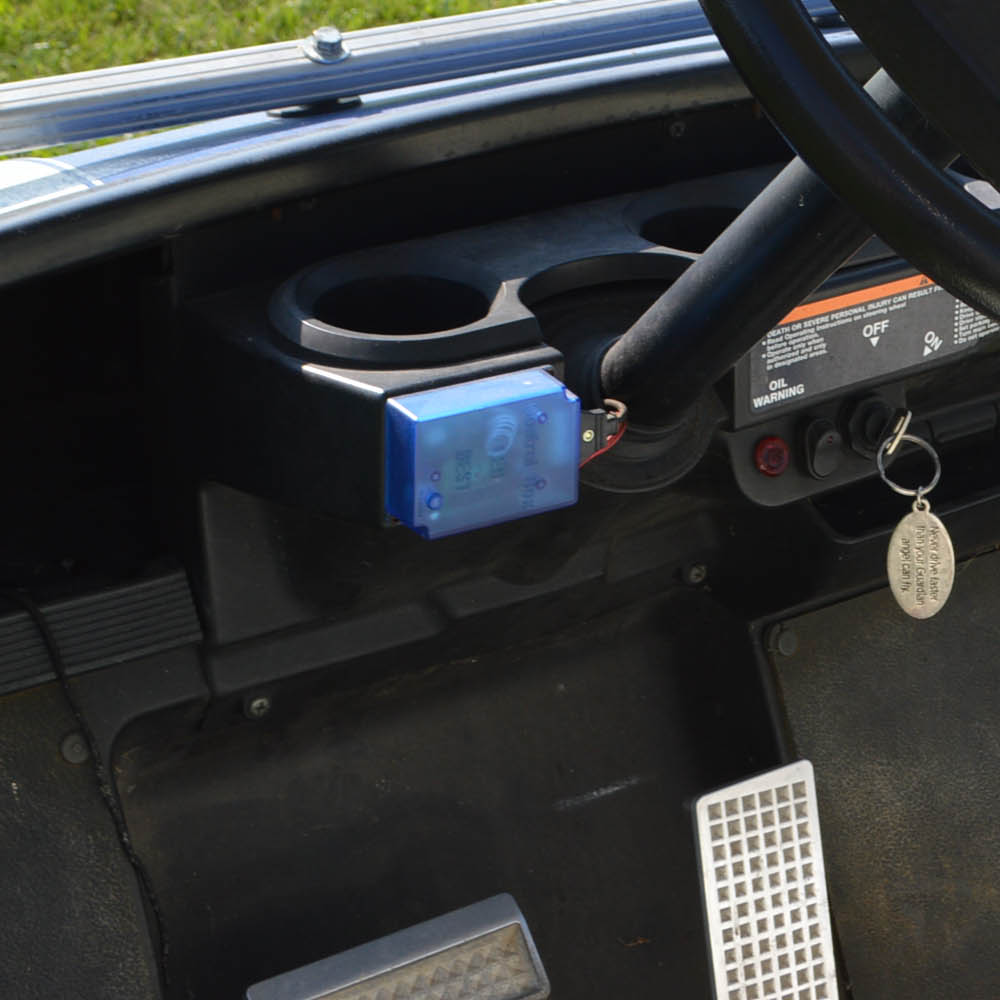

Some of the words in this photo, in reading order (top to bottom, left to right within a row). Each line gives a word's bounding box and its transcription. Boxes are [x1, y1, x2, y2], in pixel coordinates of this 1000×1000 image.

[791, 323, 802, 331] OR
[803, 316, 829, 328] SEVERE
[831, 307, 866, 320] PERSONAL
[868, 299, 892, 311] INJURY
[892, 295, 908, 305] CAN
[909, 287, 934, 300] RESULT
[862, 320, 890, 338] OFF
[924, 331, 943, 351] ON
[769, 378, 788, 391] OIL
[752, 383, 805, 409] WARNING
[915, 525, 926, 544] than
[928, 526, 940, 552] Never
[900, 537, 913, 562] angel
[911, 546, 924, 566] your
[902, 563, 911, 580] can
[929, 553, 941, 575] drive
[914, 567, 926, 606] Guardian
[929, 577, 940, 601] faster
